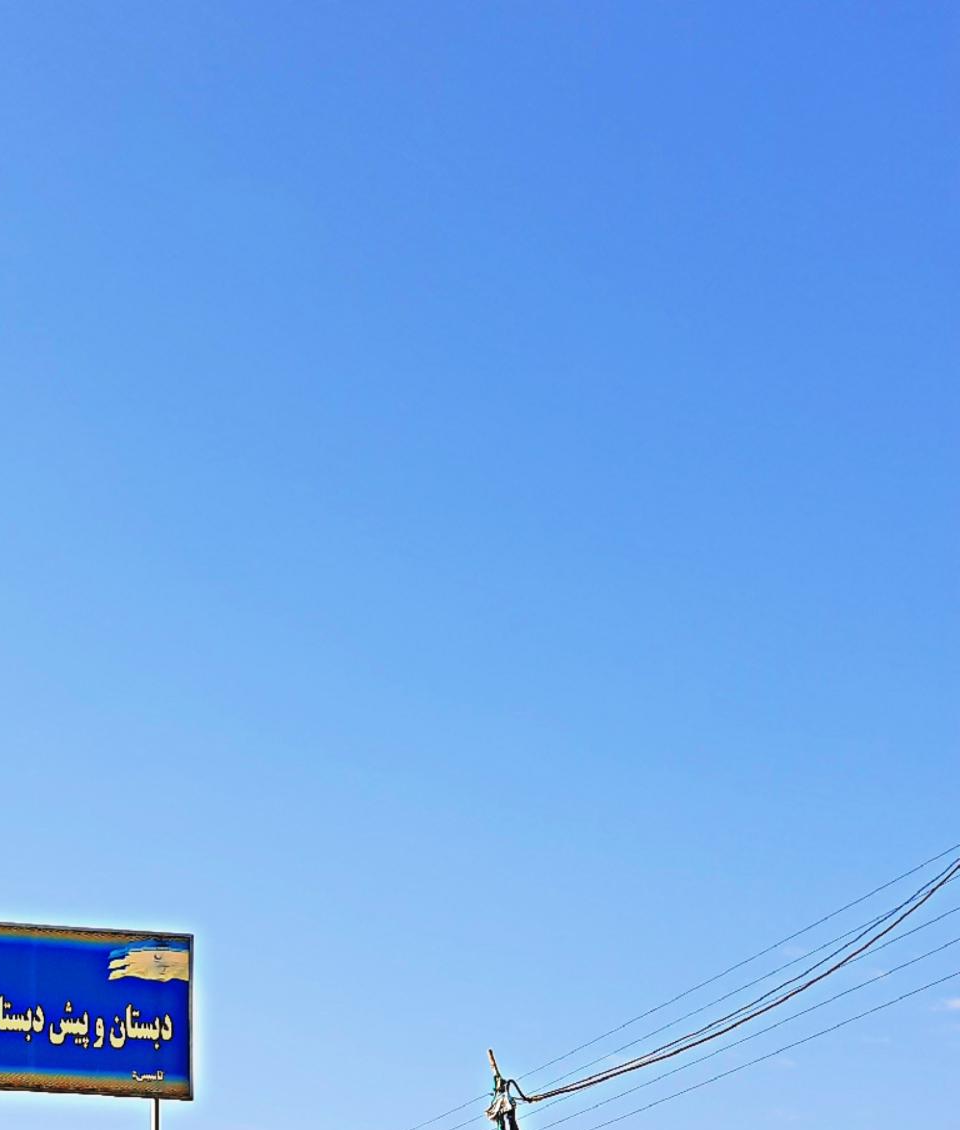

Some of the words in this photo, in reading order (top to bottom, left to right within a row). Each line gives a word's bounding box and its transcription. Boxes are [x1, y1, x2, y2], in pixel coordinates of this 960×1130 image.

[49, 1001, 89, 1048] پیش
[93, 1016, 105, 1048] و
[109, 1003, 173, 1049] دبستان
